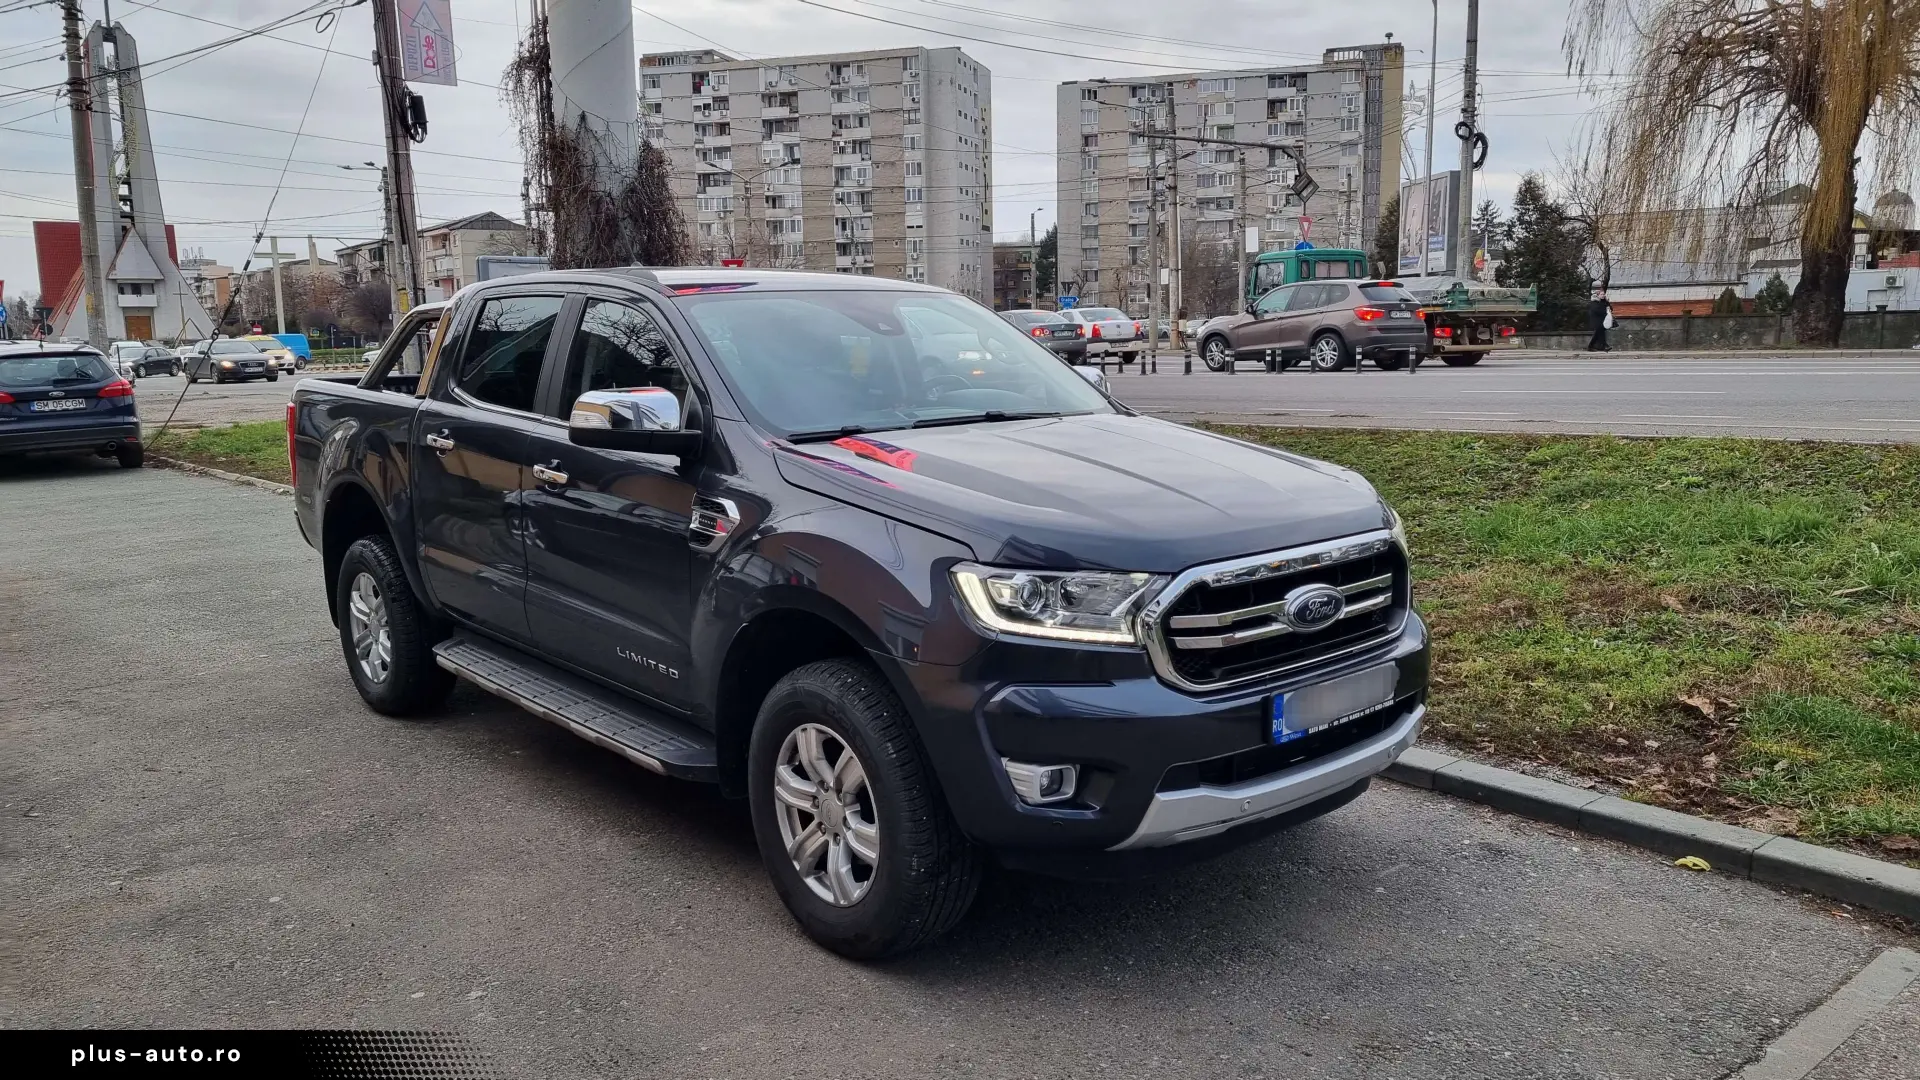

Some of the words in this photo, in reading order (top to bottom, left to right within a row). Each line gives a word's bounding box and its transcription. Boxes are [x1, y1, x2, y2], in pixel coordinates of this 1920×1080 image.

[406, 33, 418, 72] DEPOZIT
[422, 34, 436, 69] Dole
[35, 401, 50, 410] SM
[52, 399, 64, 409] 05
[65, 398, 86, 408] CGM
[1306, 596, 1335, 621] Ford
[616, 646, 679, 679] LIMITED
[1272, 718, 1283, 733] RO
